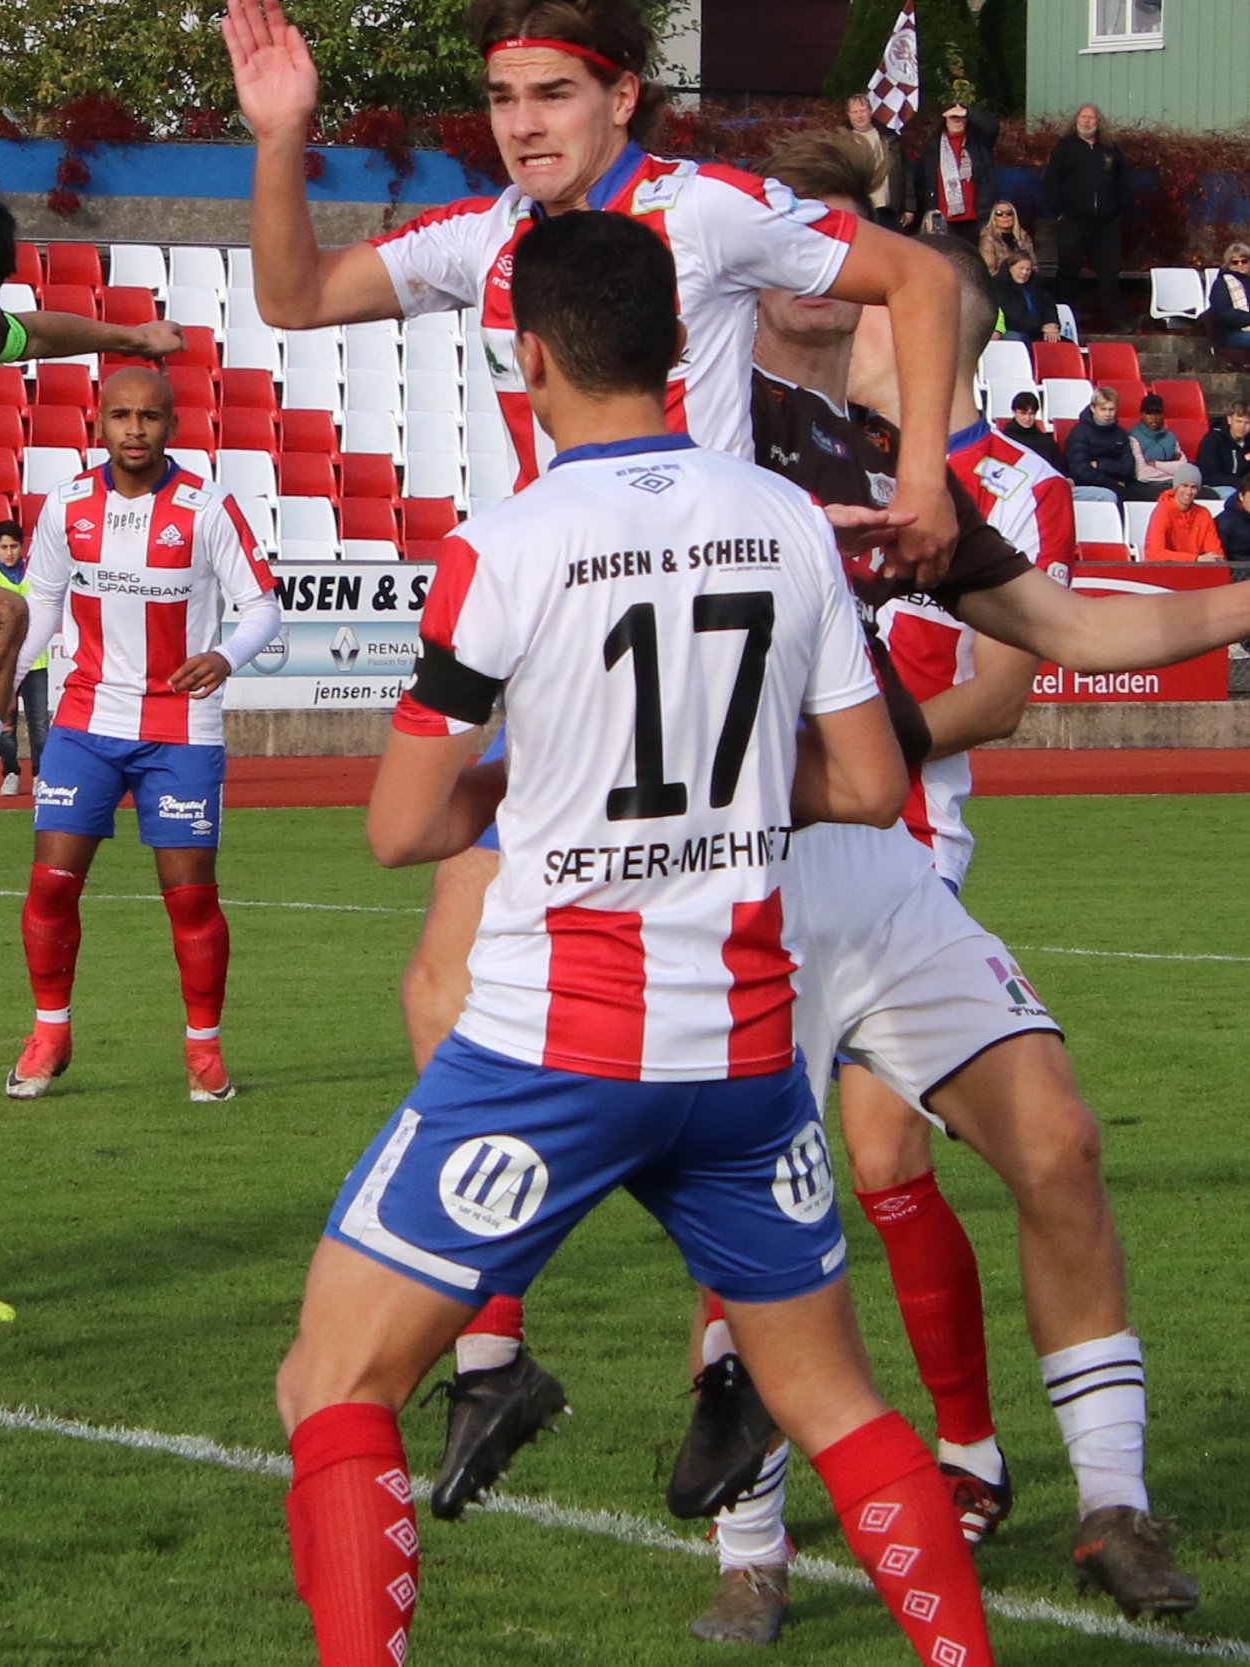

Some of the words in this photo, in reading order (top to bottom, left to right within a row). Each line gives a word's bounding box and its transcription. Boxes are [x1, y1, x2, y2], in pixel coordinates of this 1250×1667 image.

[97, 570, 141, 583] BERG
[565, 550, 652, 589] JENSEN
[661, 548, 678, 573] &
[688, 538, 780, 570] SCHEELE
[97, 582, 193, 596] SPAREBANK
[273, 575, 362, 611] NSEN
[372, 576, 398, 610] &
[368, 643, 418, 654] RENAU
[1032, 667, 1063, 693] tel
[604, 591, 775, 821] 17
